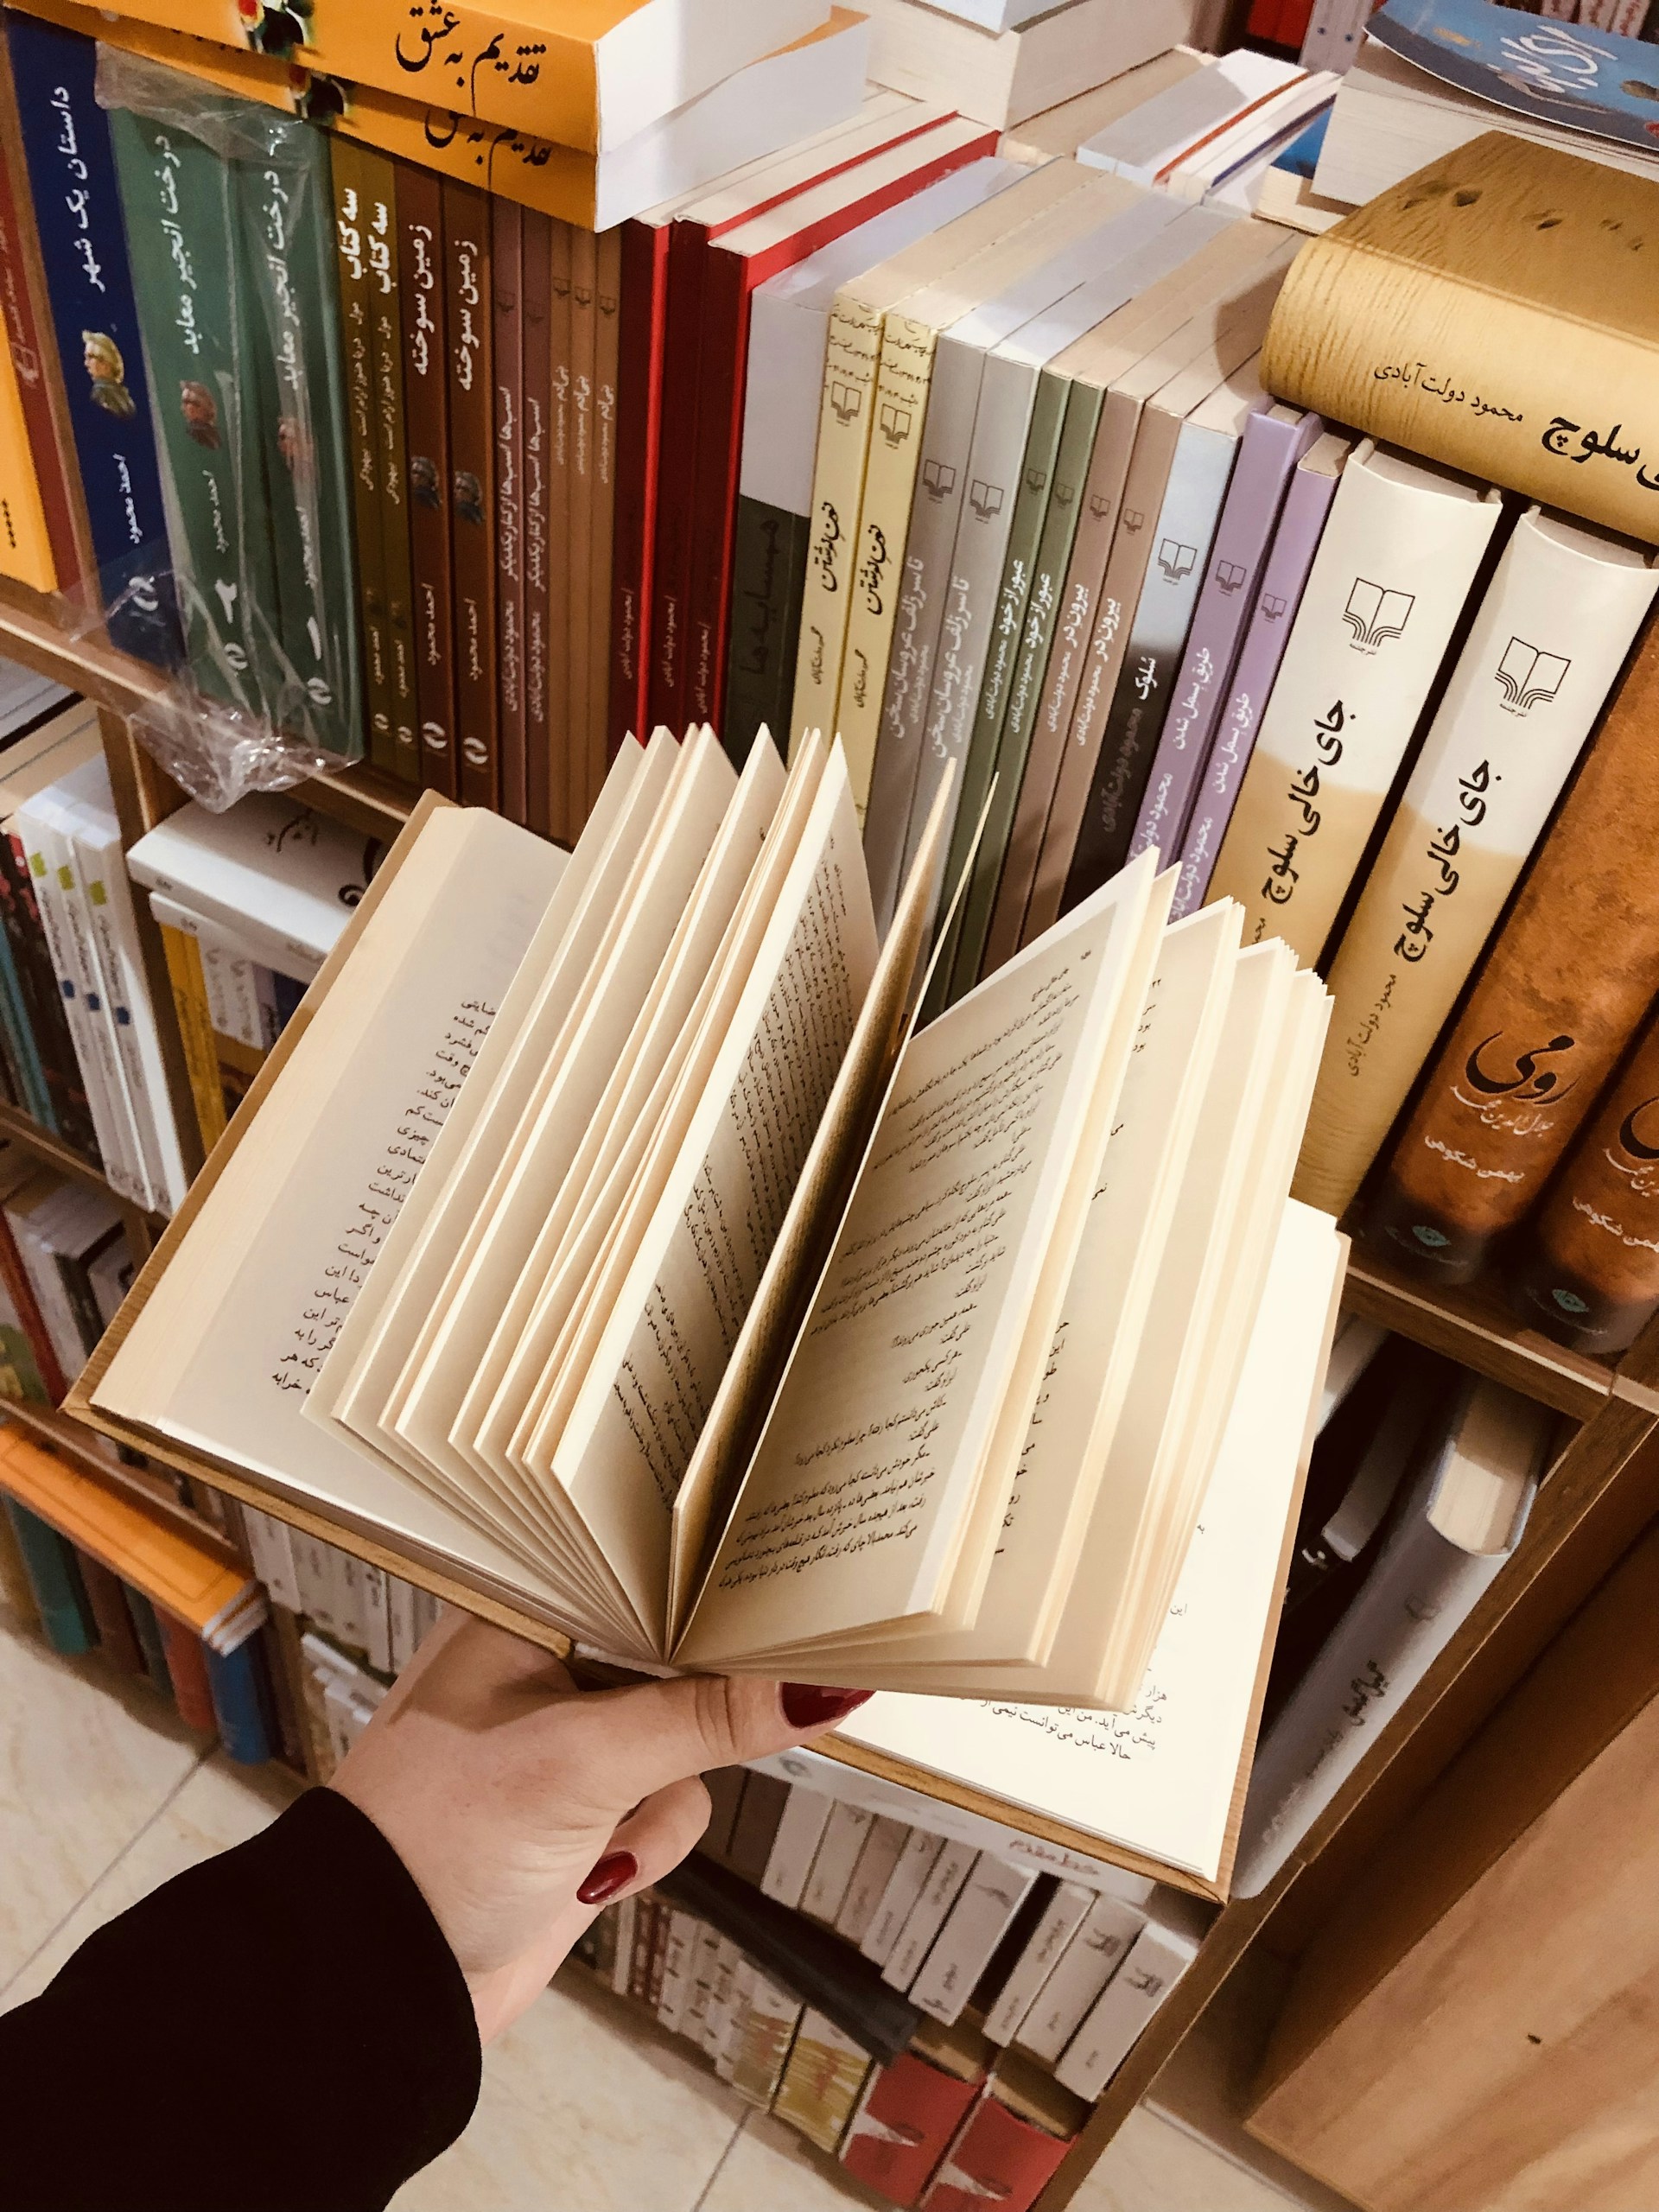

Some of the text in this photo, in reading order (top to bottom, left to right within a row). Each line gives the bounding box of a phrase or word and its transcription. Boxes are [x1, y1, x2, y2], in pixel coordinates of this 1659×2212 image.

[396, 0, 547, 118] تقدیم به عشق
[49, 86, 105, 293] داستان یک شهر
[153, 134, 203, 354] درخت انجیر معابد
[339, 187, 368, 280] سه کتاب
[366, 200, 397, 294] سه کتاب
[261, 169, 304, 391] درخت انجیر معابد
[408, 223, 435, 375] زمین سوخته
[453, 238, 480, 391] زمین سوخته
[1471, 395, 1523, 423] محمود
[1541, 416, 1641, 465] سلوچ
[421, 582, 435, 625] احمد
[997, 558, 1027, 635] عبور از خود
[1024, 572, 1053, 649] عبور از خود
[884, 555, 927, 739] تا سر زلف عروسان سخن
[926, 574, 972, 759] تا سر زلف عروسان سخن
[1162, 646, 1213, 750] طریق بسمل شدن
[1211, 691, 1253, 794] طریق بسمل شدن
[1261, 698, 1357, 905] جای خالی سلوچ
[1393, 759, 1502, 963] جای خالی سلوچ
[1374, 973, 1396, 1011] محمود
[435, 1049, 459, 1067] وقت
[396, 1126, 429, 1146] چیزی
[344, 1223, 374, 1237] اگر
[313, 1287, 349, 1305] عباس
[323, 1265, 348, 1279] این
[302, 1306, 327, 1321] این
[270, 1371, 302, 1390] خرابه
[279, 1352, 298, 1363] هر
[1075, 1735, 1107, 1751] عباس
[1110, 1742, 1132, 1760] حالا
